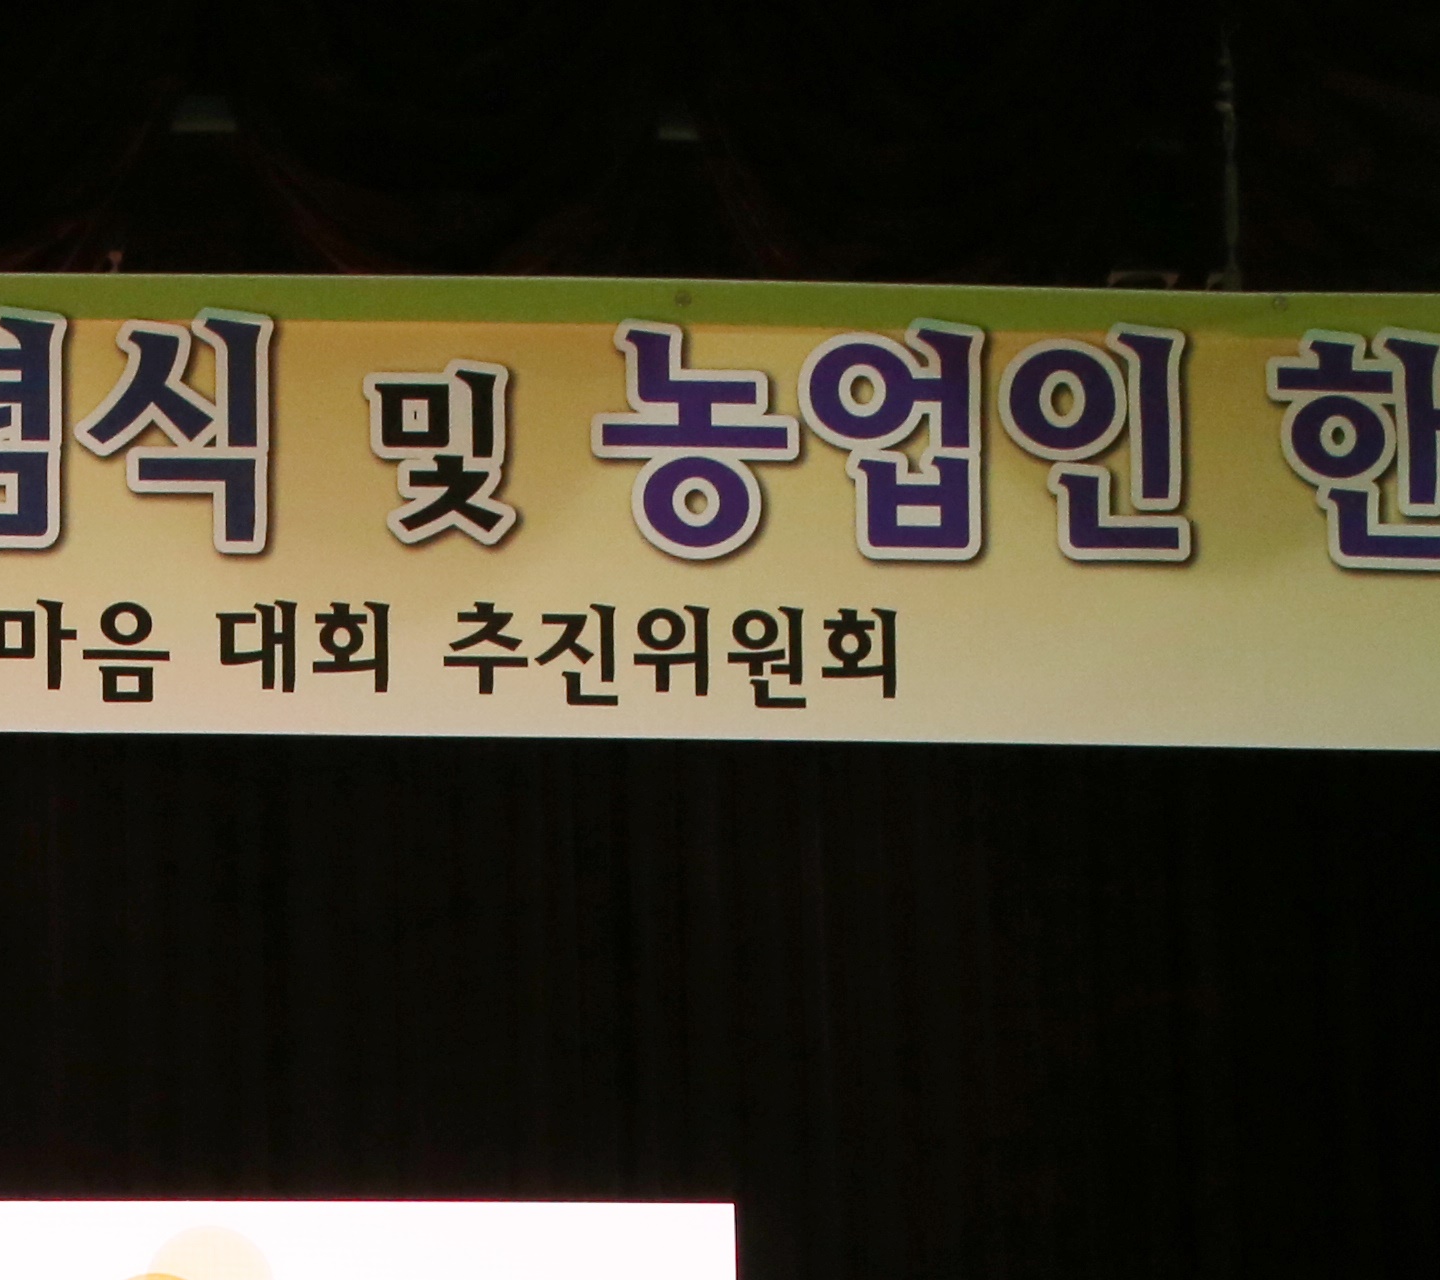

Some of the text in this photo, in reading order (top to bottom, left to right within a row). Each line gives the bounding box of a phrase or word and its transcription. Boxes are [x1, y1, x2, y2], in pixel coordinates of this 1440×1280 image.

[363, 359, 516, 549] 및
[591, 317, 1191, 561] 농업인
[216, 601, 391, 697] 대회
[443, 601, 899, 709] 추진위원회
